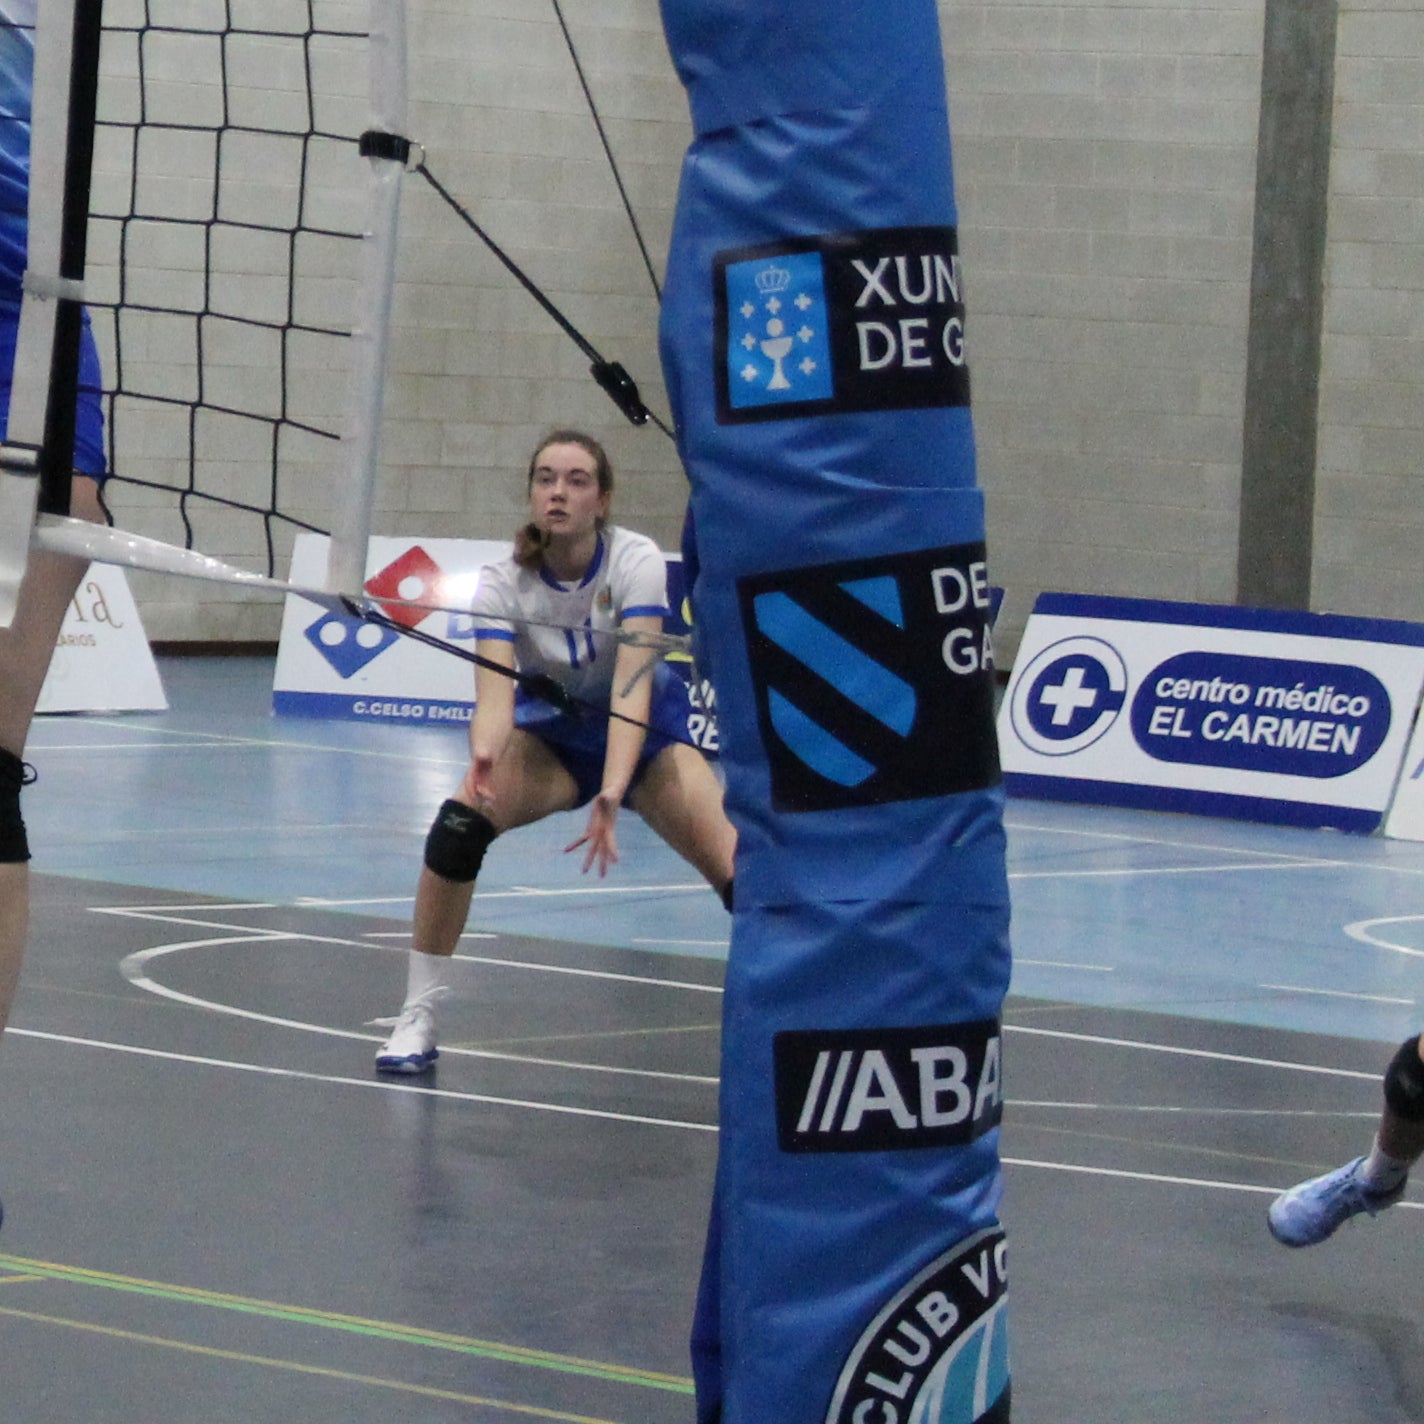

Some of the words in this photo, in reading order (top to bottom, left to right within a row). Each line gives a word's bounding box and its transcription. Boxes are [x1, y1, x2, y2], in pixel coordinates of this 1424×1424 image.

[856, 319, 932, 370] DE
[1155, 676, 1251, 705] centro
[1254, 682, 1371, 718] médico
[1148, 706, 1193, 739] EL
[1202, 711, 1362, 756] CARMEN
[852, 1290, 960, 1424] CLUB
